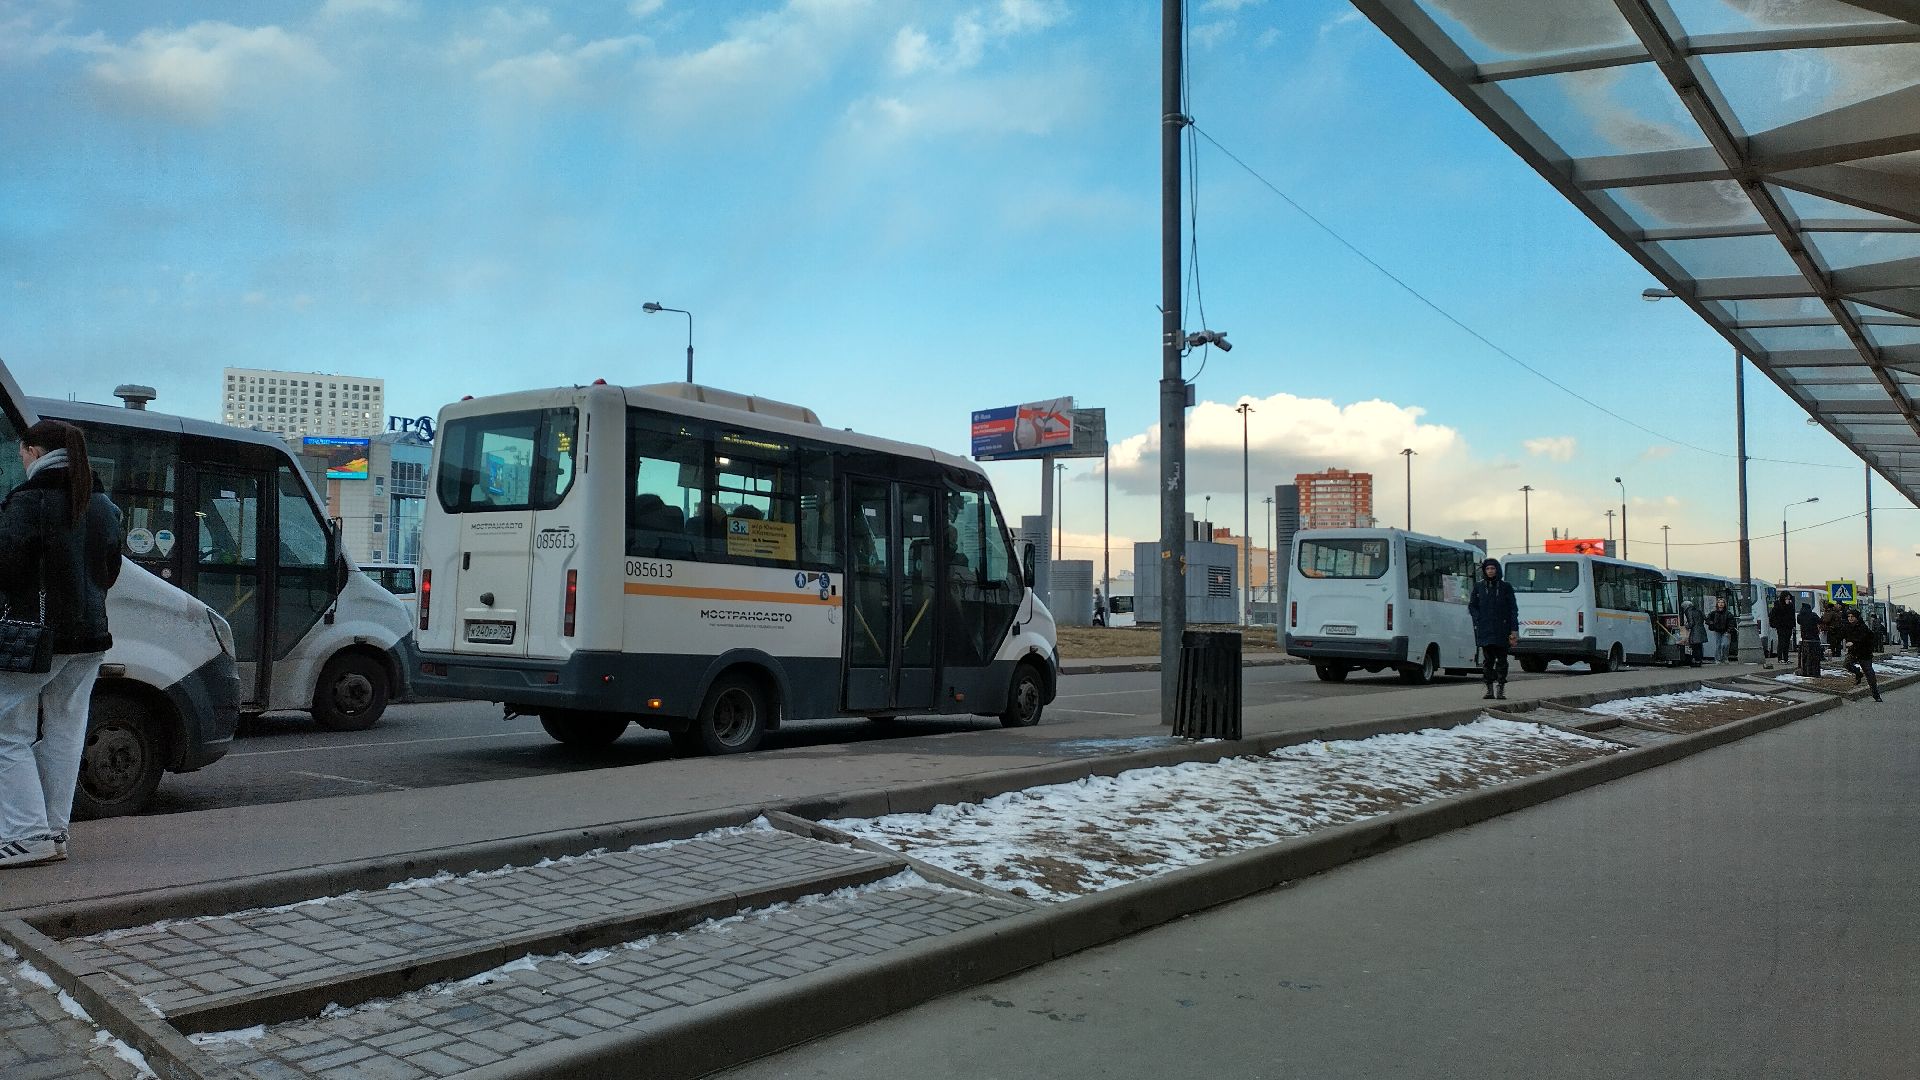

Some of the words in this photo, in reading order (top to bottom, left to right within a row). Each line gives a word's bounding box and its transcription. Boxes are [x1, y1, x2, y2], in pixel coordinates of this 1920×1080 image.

[535, 533, 576, 550] 085613
[625, 560, 673, 578] 085613
[700, 609, 793, 623] МОСТРАНСАВТО
